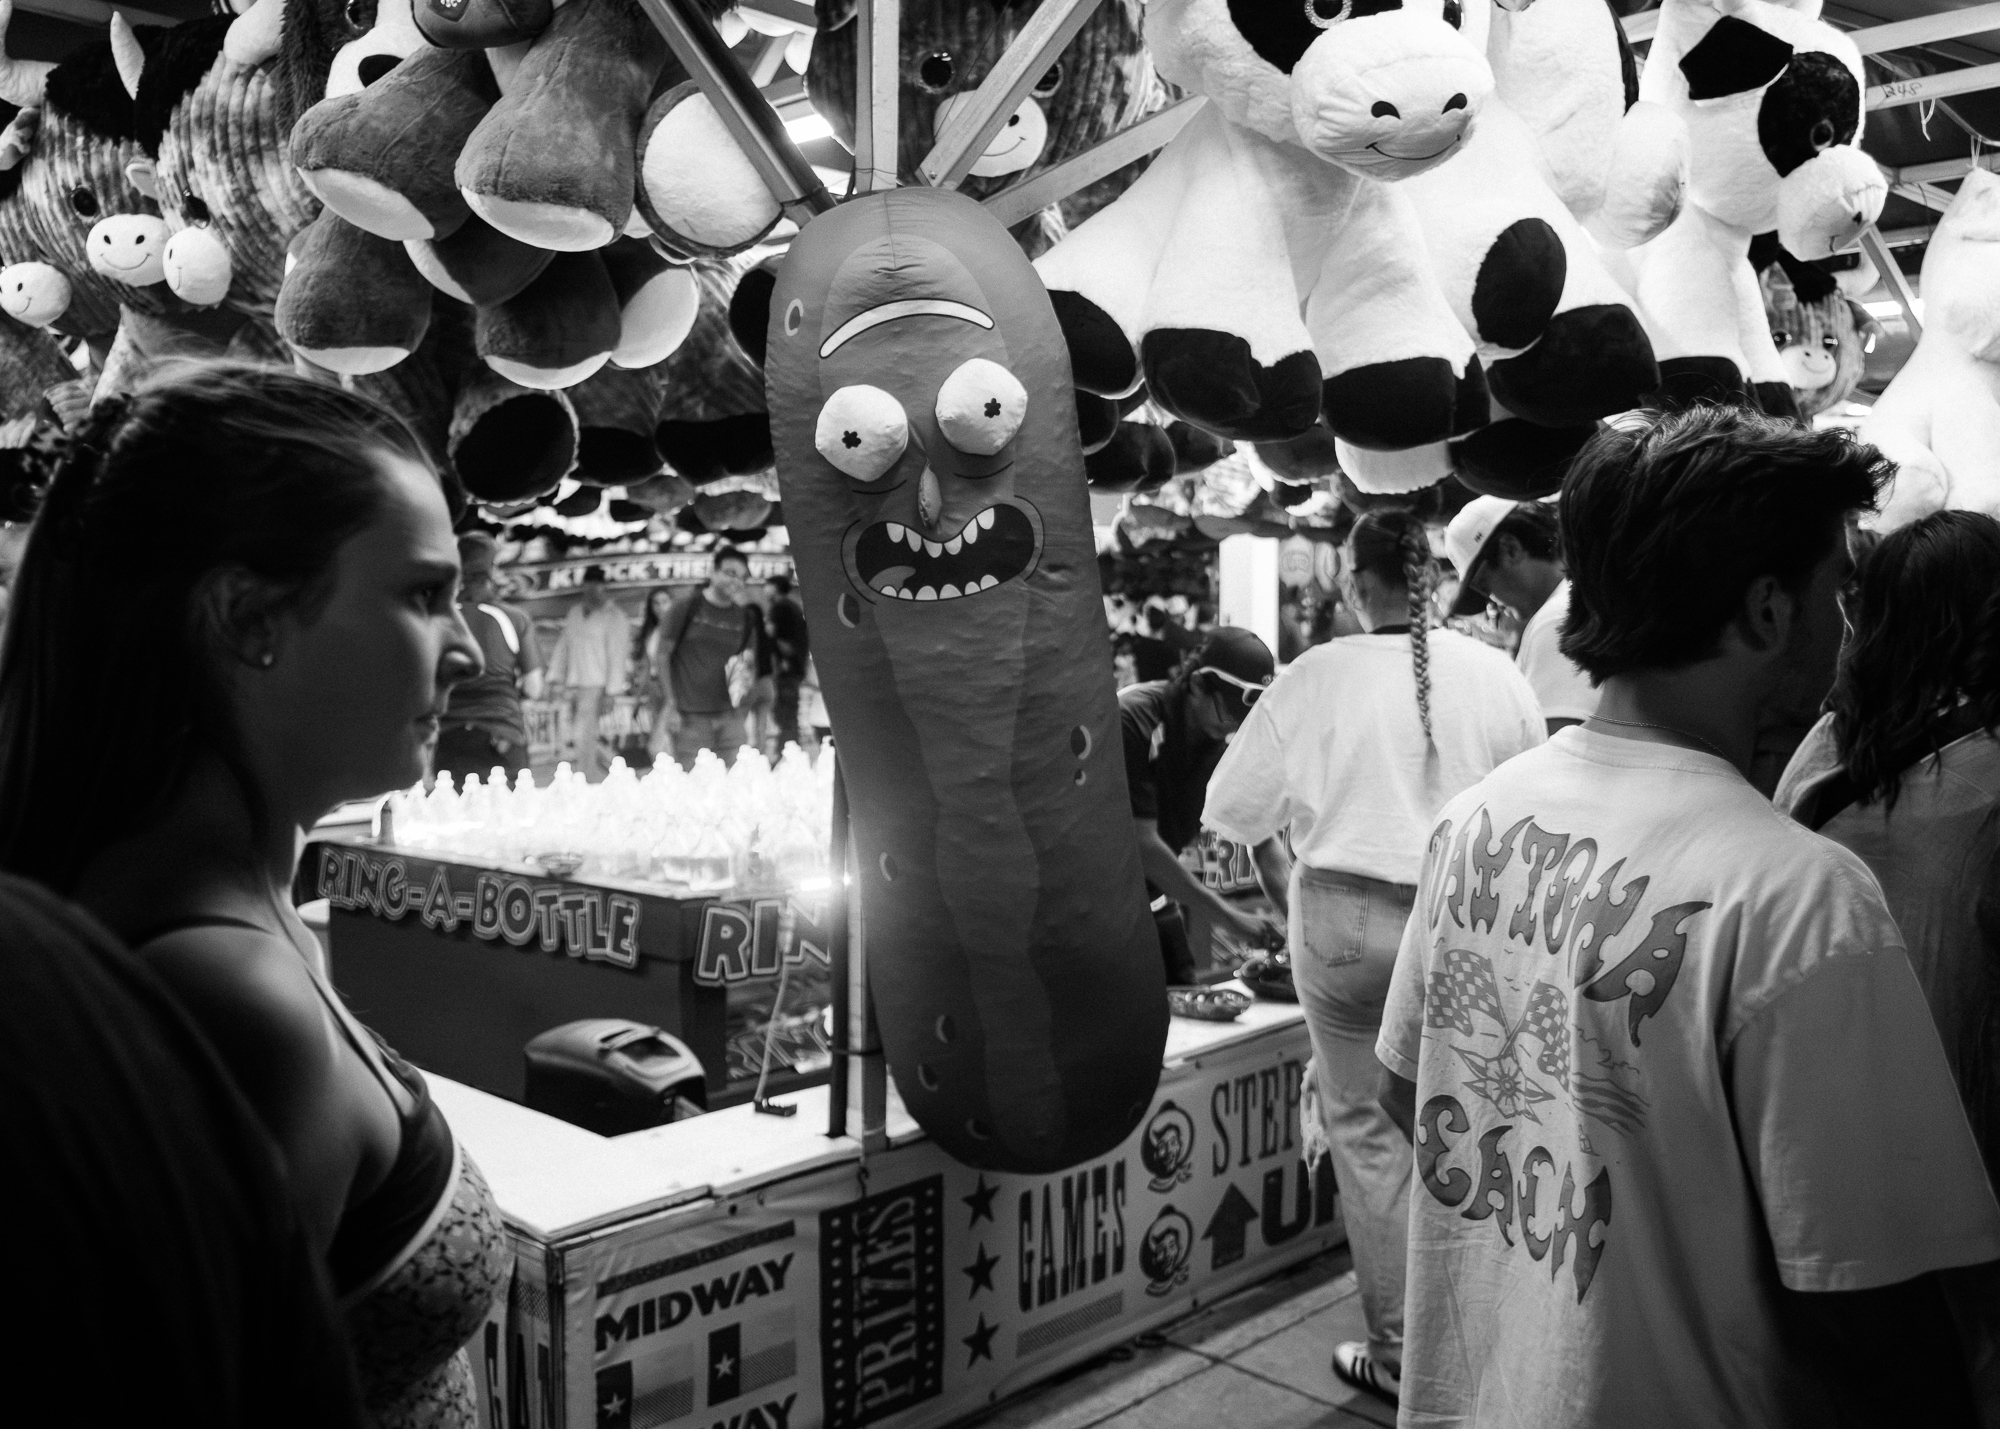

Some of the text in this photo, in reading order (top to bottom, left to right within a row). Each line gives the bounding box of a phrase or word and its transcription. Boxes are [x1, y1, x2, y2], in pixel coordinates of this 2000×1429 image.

[317, 846, 640, 969] RING-A-BOTTLE
[1210, 1060, 1302, 1178] STEP
[1018, 1159, 1126, 1313] GAMES
[595, 1252, 795, 1353] MIDWAY
[852, 1196, 917, 1419] PRIZES
